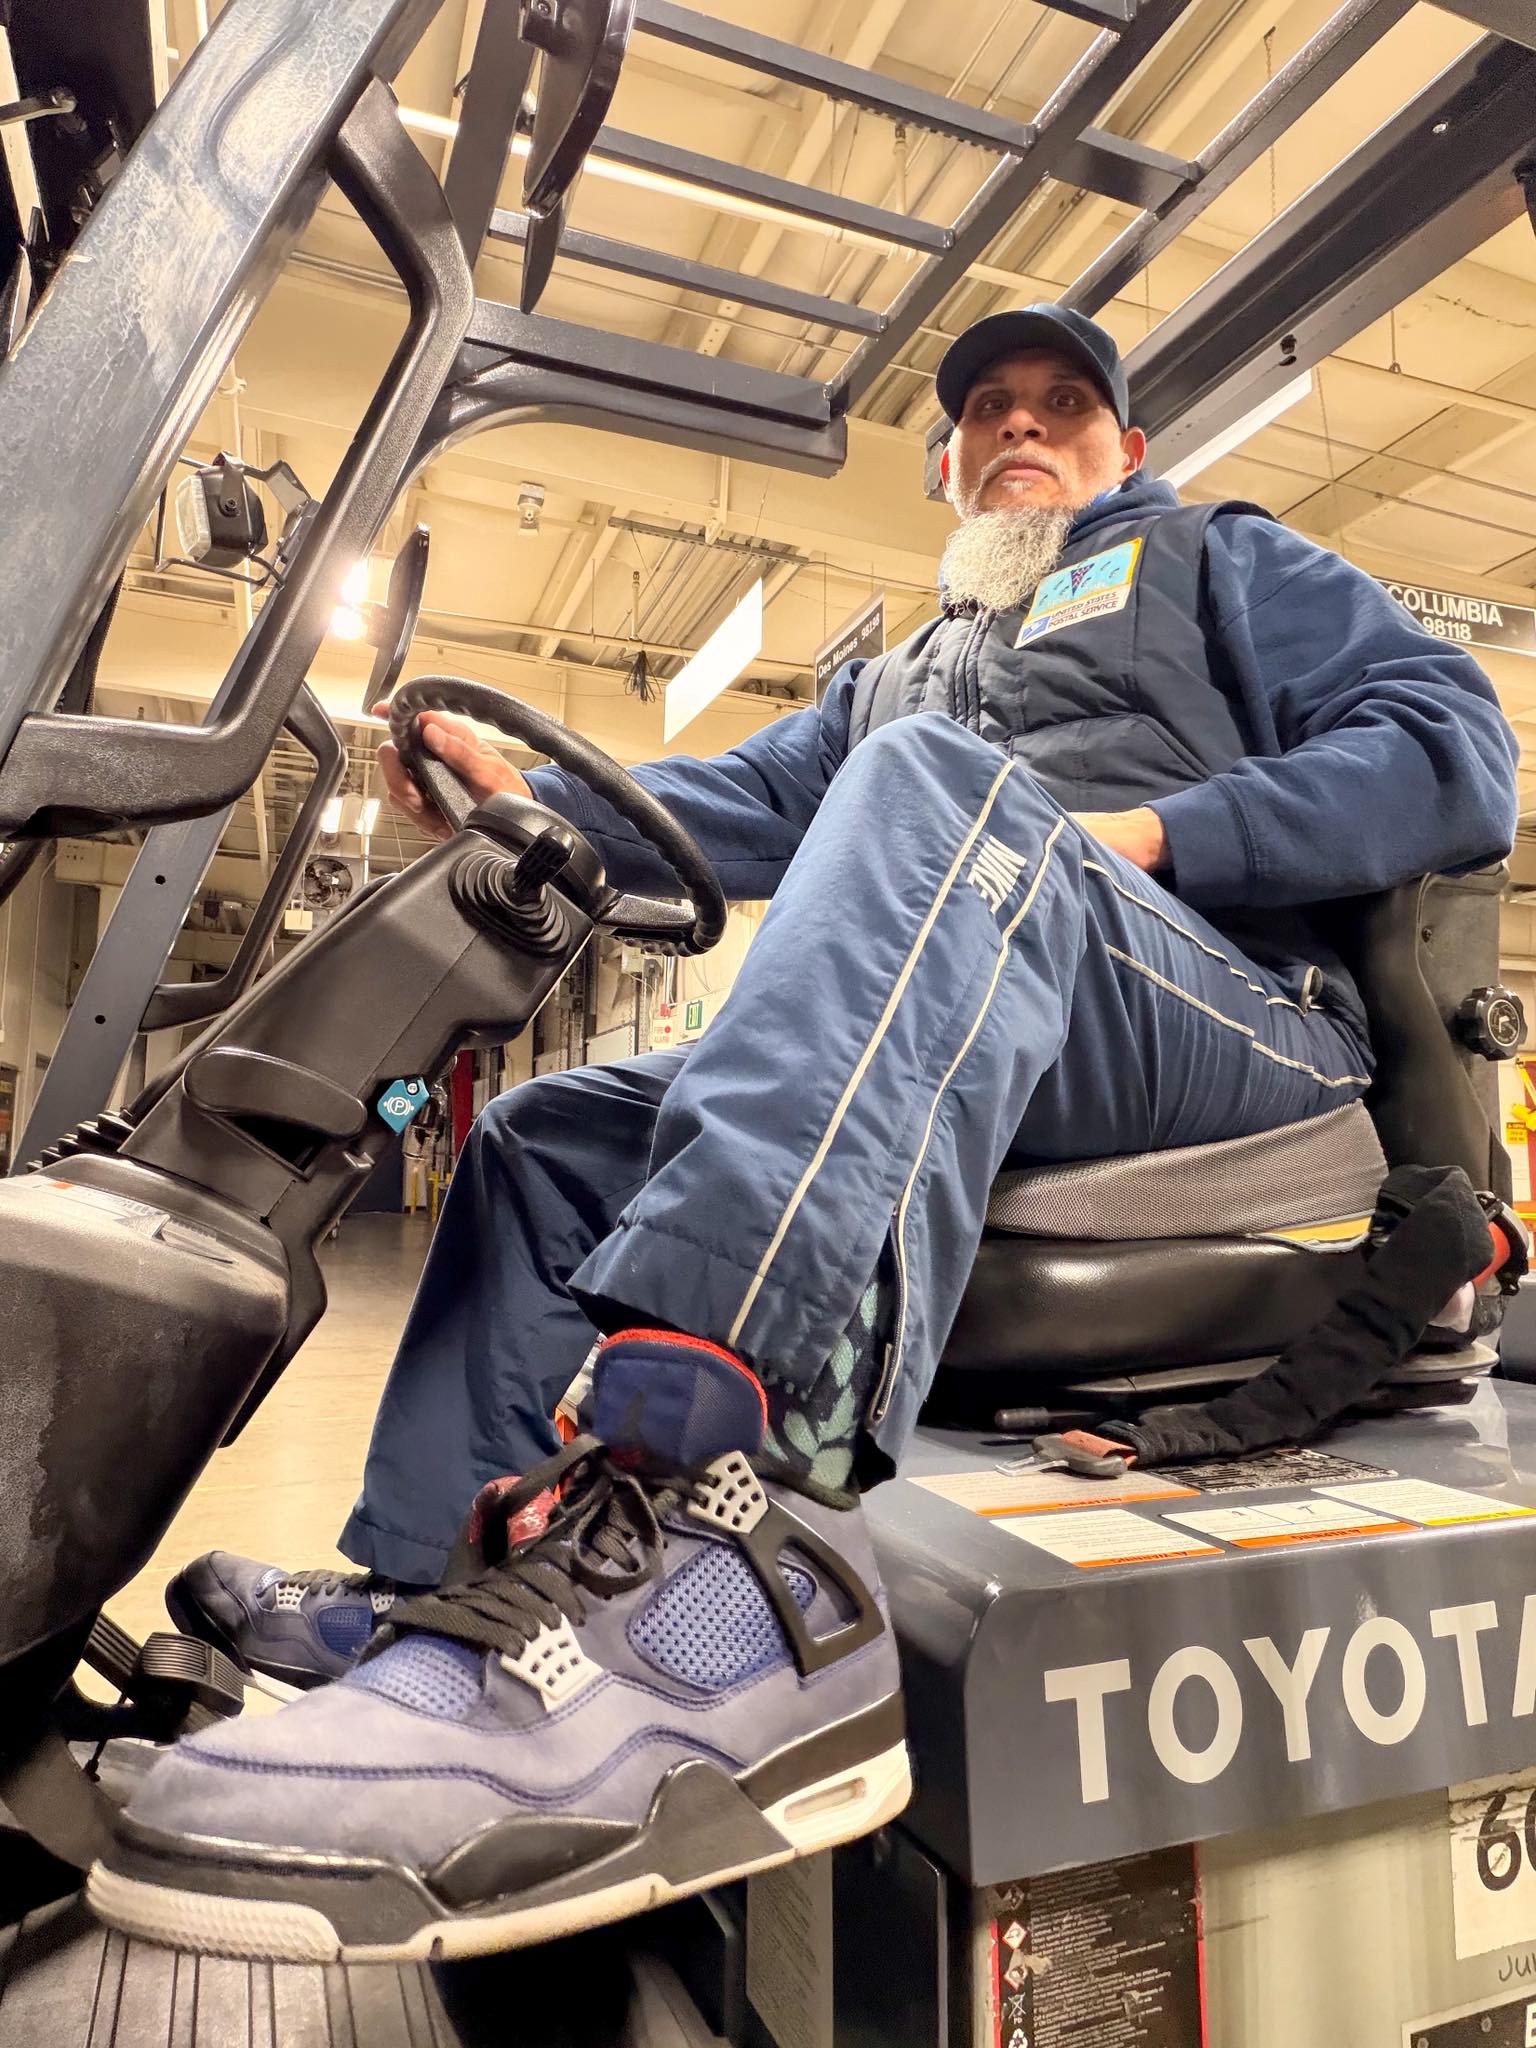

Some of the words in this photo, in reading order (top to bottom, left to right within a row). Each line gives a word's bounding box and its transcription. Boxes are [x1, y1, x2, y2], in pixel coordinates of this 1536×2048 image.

[1048, 612, 1078, 627] POSTAL
[1081, 600, 1117, 616] SERVICE
[1051, 603, 1083, 618] UNITED
[1086, 592, 1117, 605] STATES
[1387, 584, 1503, 628] COLUMBIA
[1422, 615, 1473, 642] 98118
[818, 660, 832, 680] Des
[832, 636, 858, 667] Moines
[966, 834, 1028, 916] NIKE
[1476, 1786, 1536, 1891] 6
